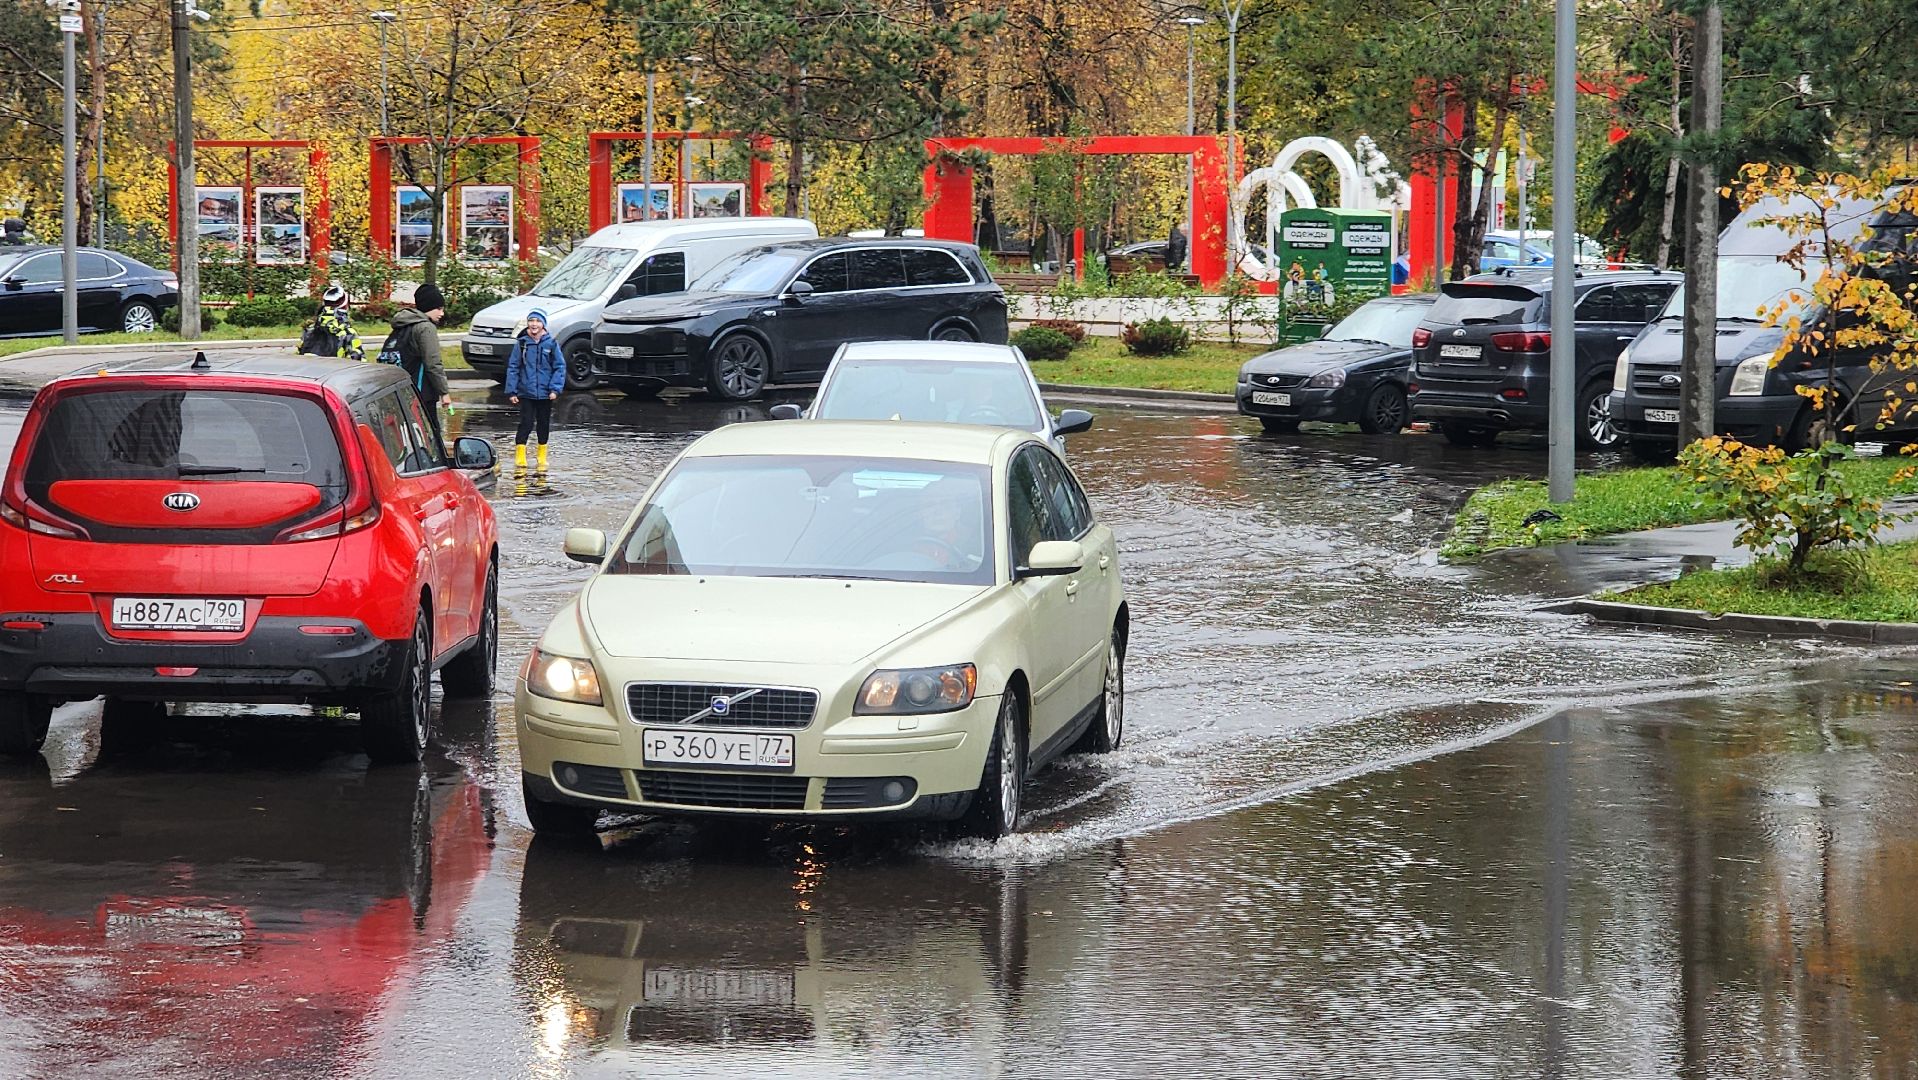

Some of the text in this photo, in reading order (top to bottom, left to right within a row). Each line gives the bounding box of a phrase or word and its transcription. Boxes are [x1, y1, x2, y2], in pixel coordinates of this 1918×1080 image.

[168, 496, 194, 507] KIA
[120, 602, 238, 623] Н887АС 790
[655, 735, 783, 761] Р360УЕ 77
